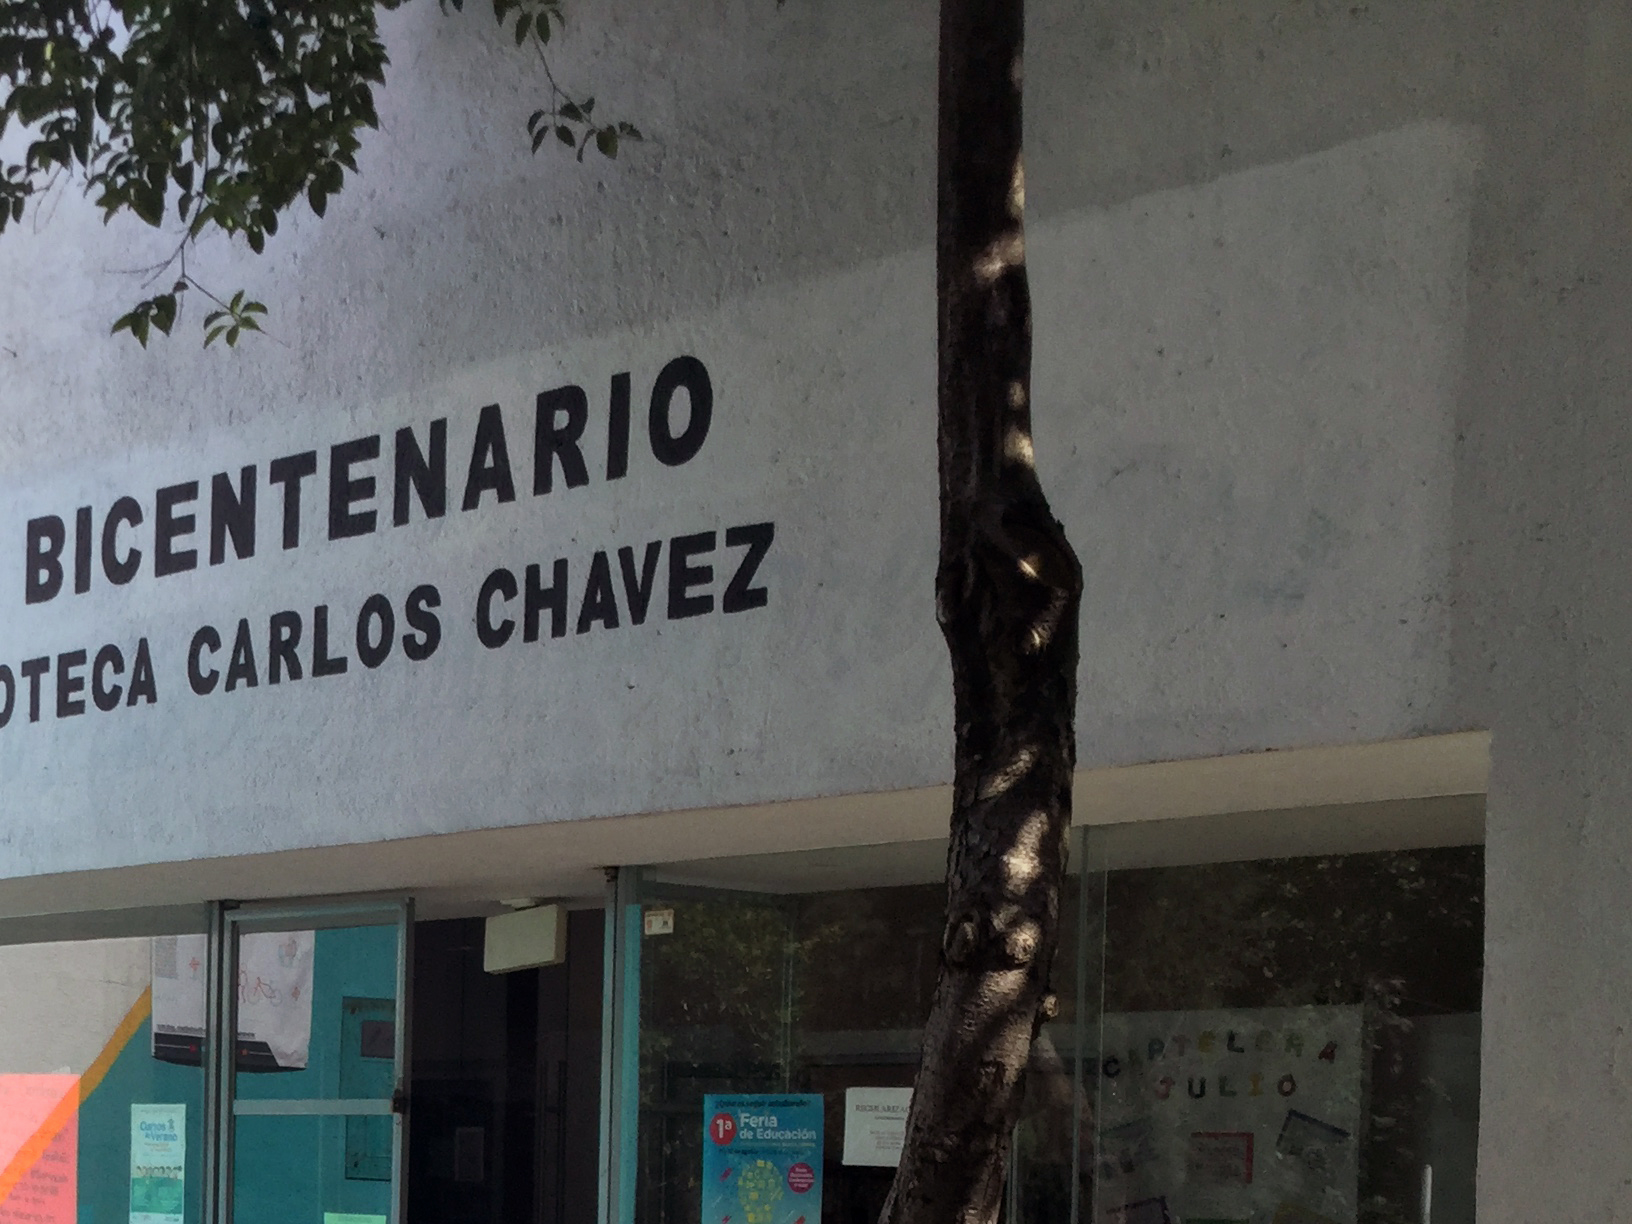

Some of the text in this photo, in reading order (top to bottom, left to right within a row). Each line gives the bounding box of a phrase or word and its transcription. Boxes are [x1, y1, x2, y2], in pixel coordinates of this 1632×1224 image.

[24, 354, 713, 604] BICENTENARIO
[187, 584, 442, 698] CARLOS
[475, 523, 776, 650] CHAVEZ
[1155, 1072, 1297, 1100] JULIO
[739, 1112, 778, 1128] Feria
[739, 1127, 817, 1140] de Educación
